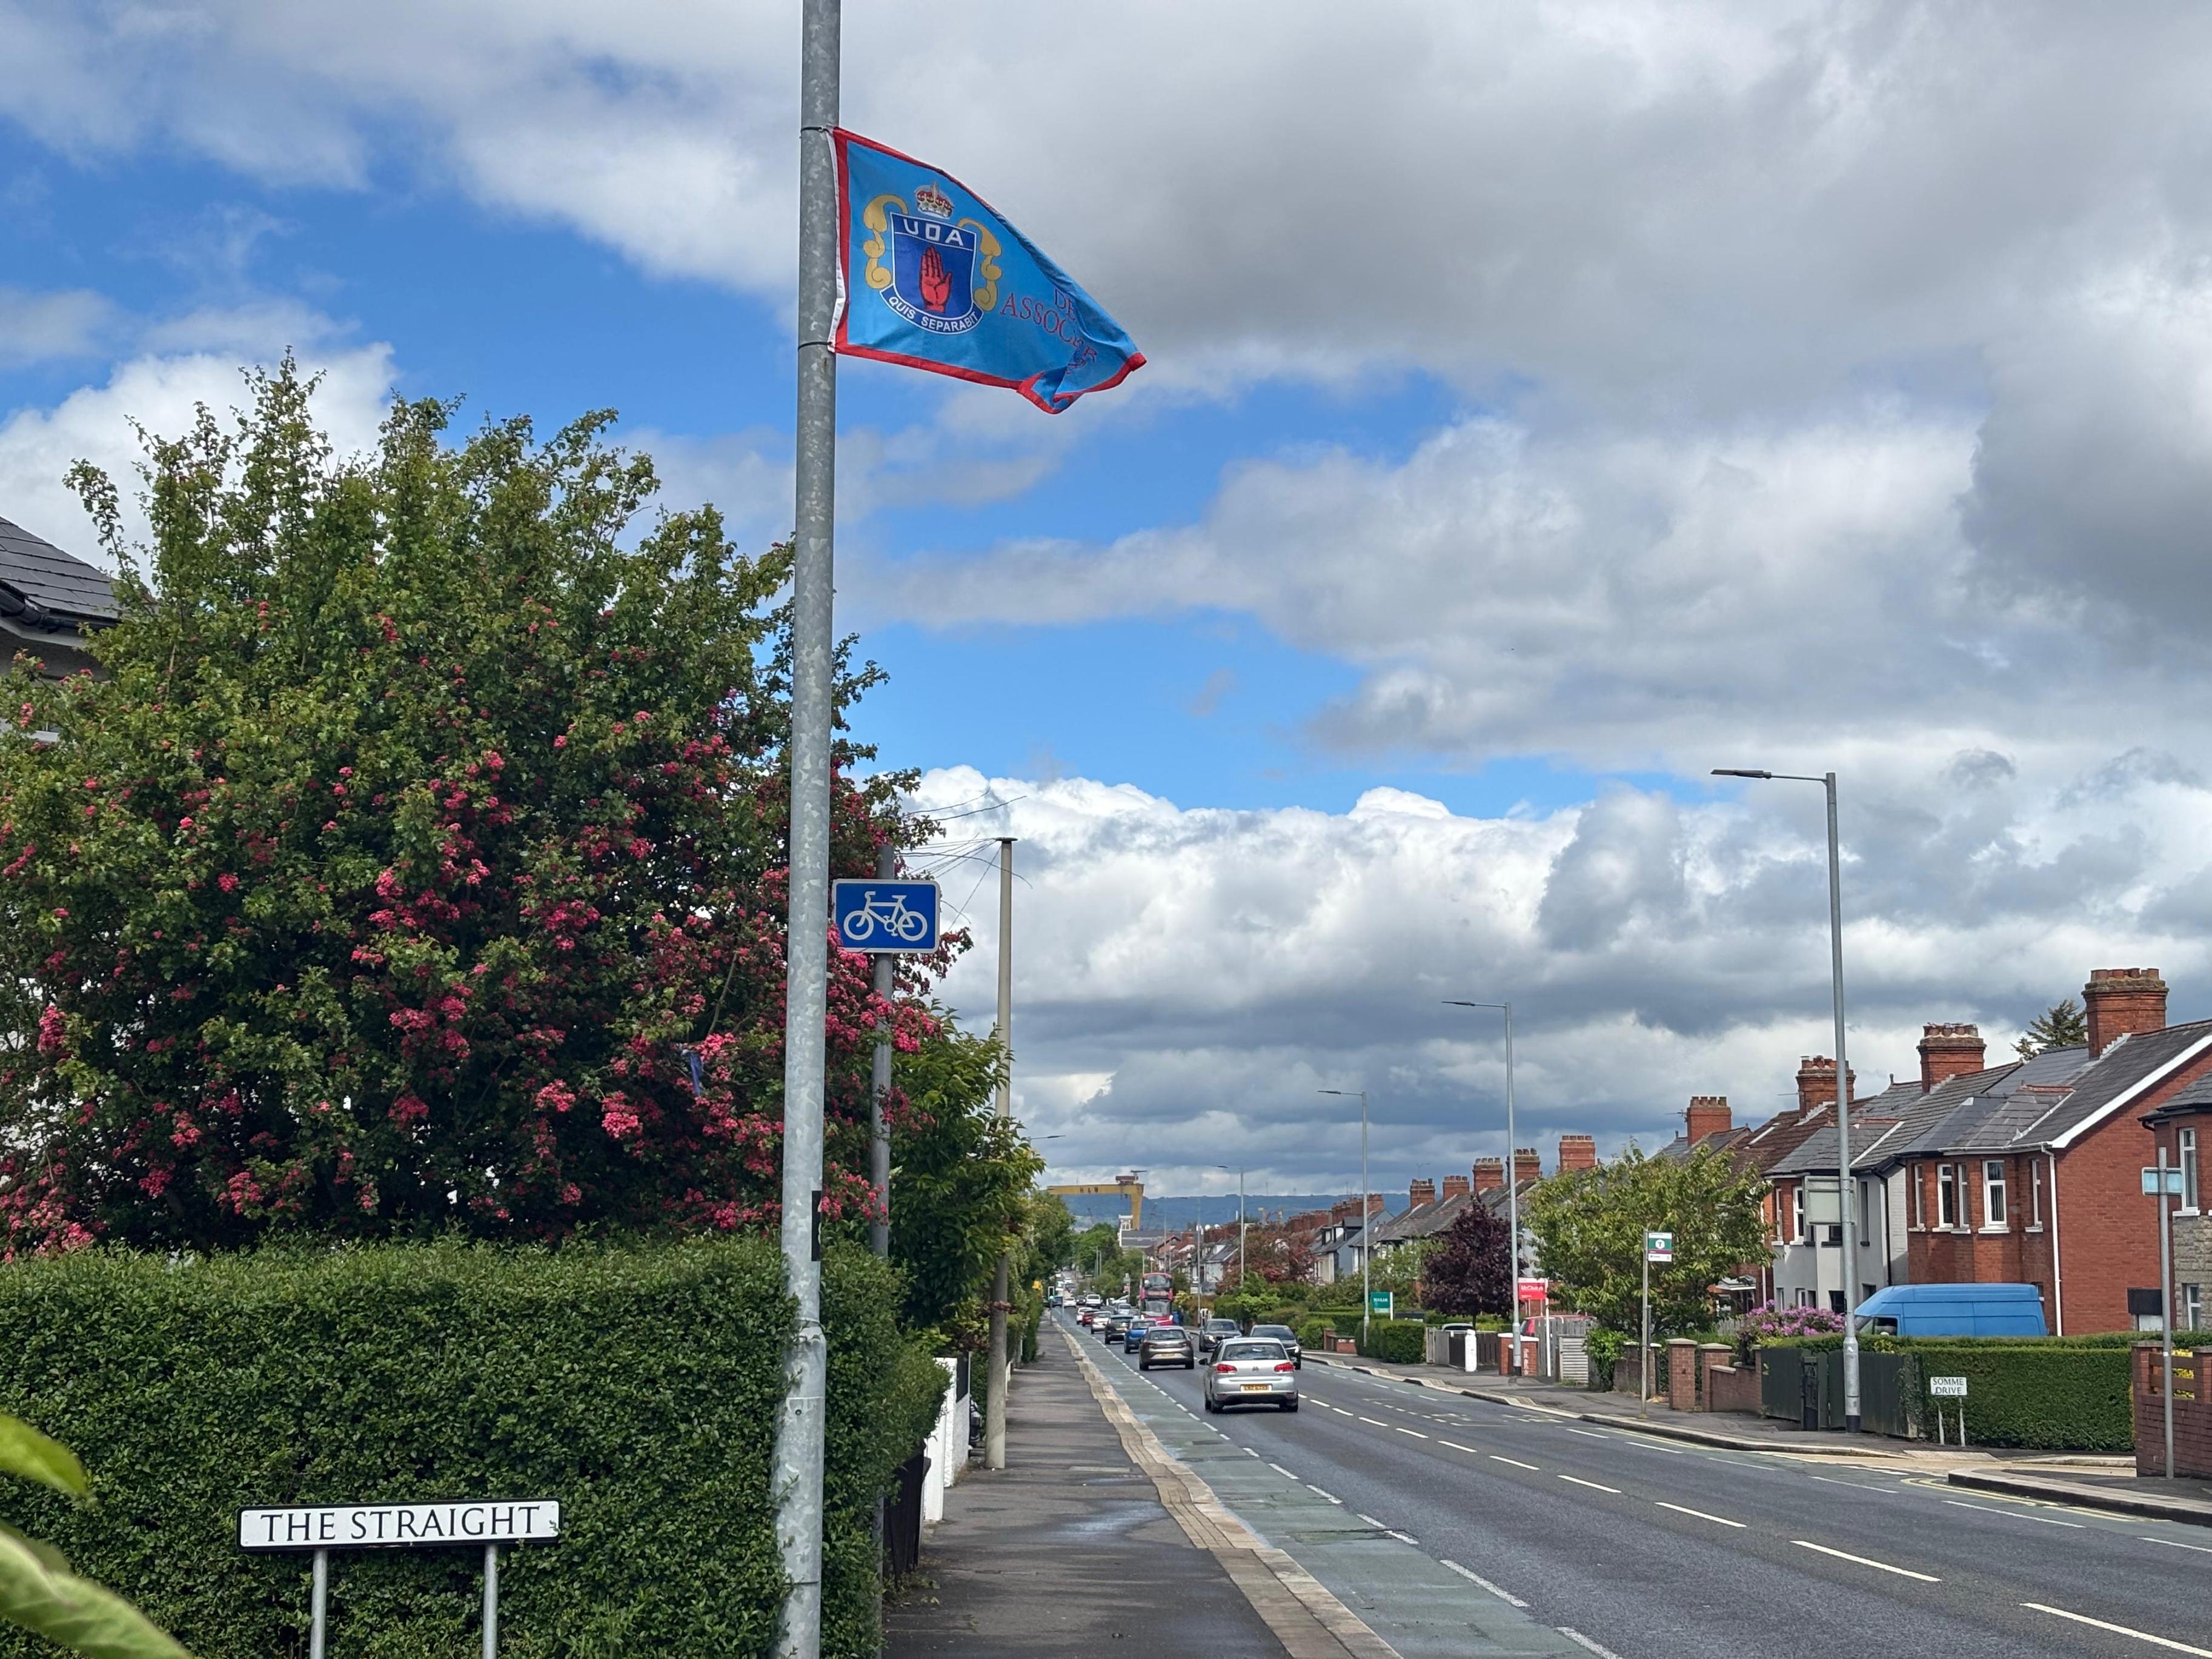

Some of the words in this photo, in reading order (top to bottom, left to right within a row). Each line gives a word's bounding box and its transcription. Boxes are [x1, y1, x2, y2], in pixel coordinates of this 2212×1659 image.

[889, 296, 916, 319] QUIS
[921, 311, 978, 332] SEPARABIT
[1933, 1377, 1964, 1386] SOMME
[261, 1512, 336, 1542] THE
[350, 1506, 540, 1540] STRAIGHT
